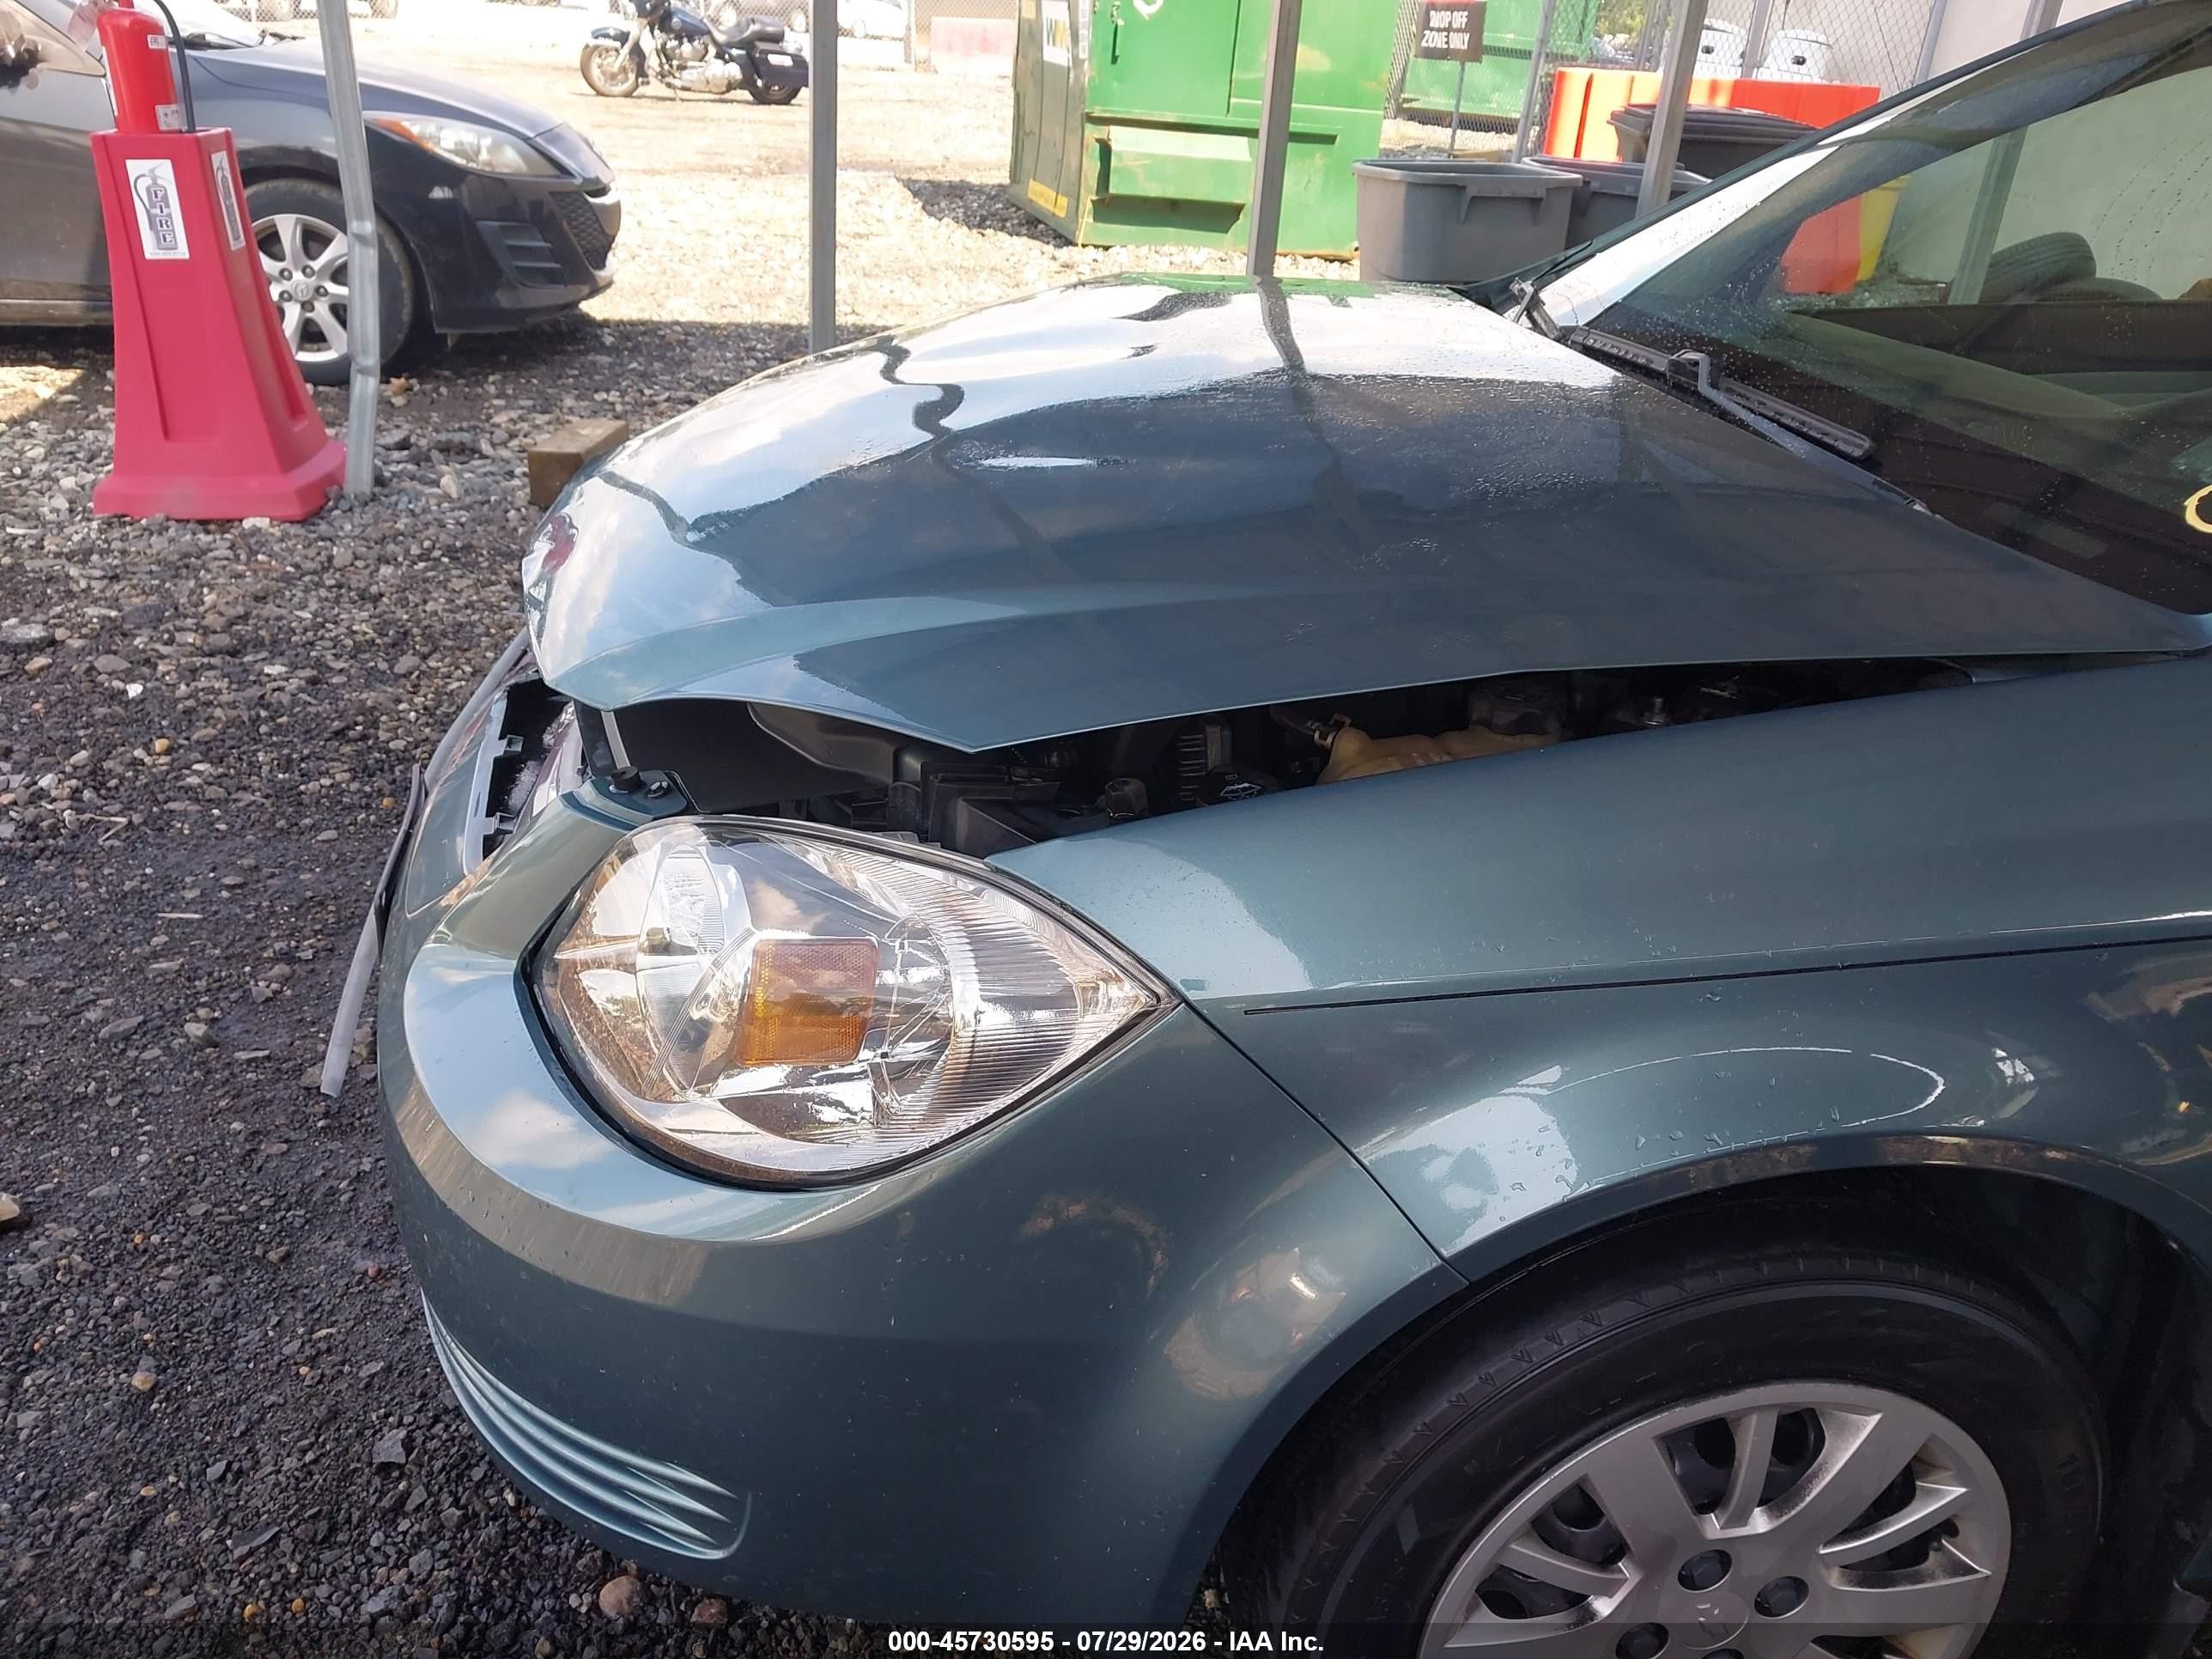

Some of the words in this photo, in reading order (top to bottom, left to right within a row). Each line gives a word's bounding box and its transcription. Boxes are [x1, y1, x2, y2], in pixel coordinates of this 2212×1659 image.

[1452, 10, 1468, 29] OFF
[1421, 29, 1448, 49] ZONE
[1449, 31, 1470, 50] ONLY
[151, 187, 175, 245] FIRE
